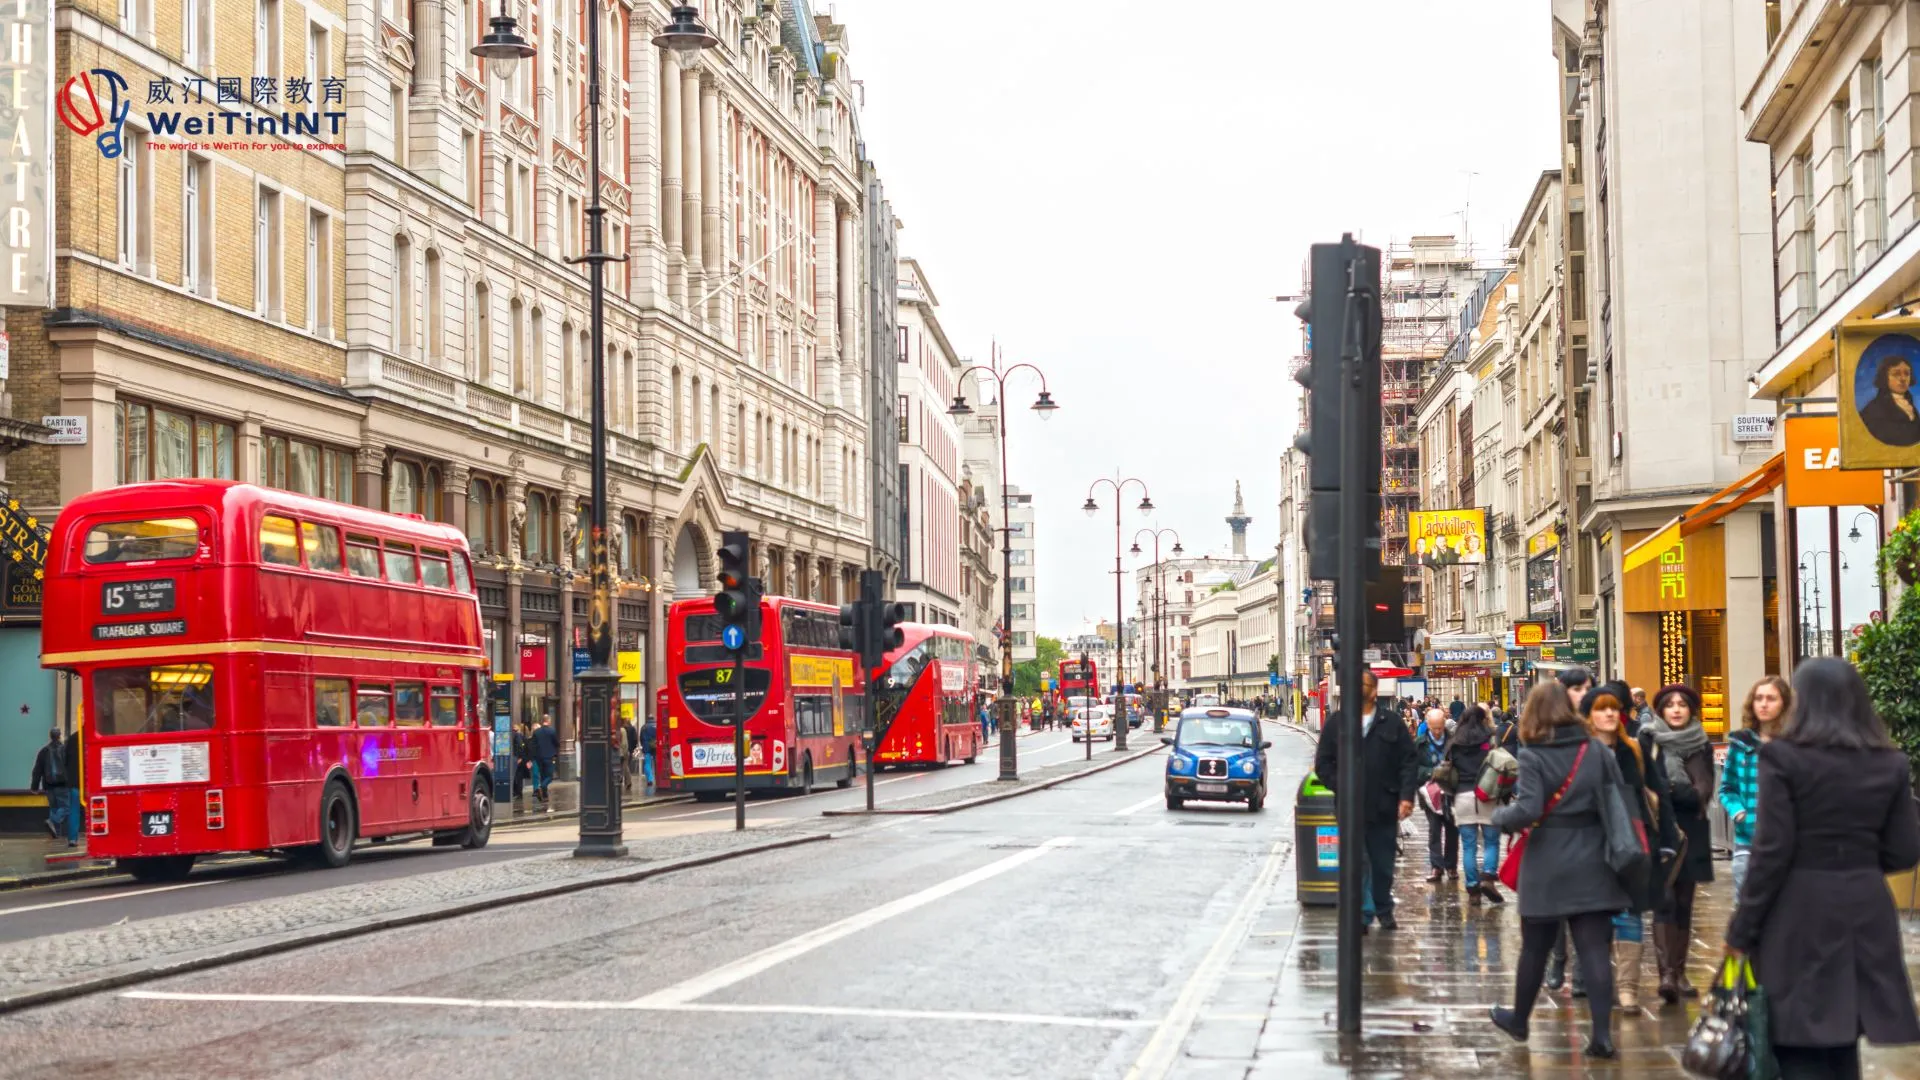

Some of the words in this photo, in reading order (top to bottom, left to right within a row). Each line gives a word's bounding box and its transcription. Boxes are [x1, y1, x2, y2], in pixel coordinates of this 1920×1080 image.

[46, 418, 77, 427] CARTING
[67, 427, 82, 435] WC2
[1737, 425, 1762, 433] STREET
[1804, 447, 1840, 470] EA
[1417, 515, 1477, 539] Ladykillers
[106, 586, 124, 609] 15
[97, 624, 146, 638] TRAFALGAR
[149, 621, 184, 635] SQUARE
[622, 662, 637, 670] itsu
[716, 669, 733, 683] 87
[887, 677, 896, 688] 9
